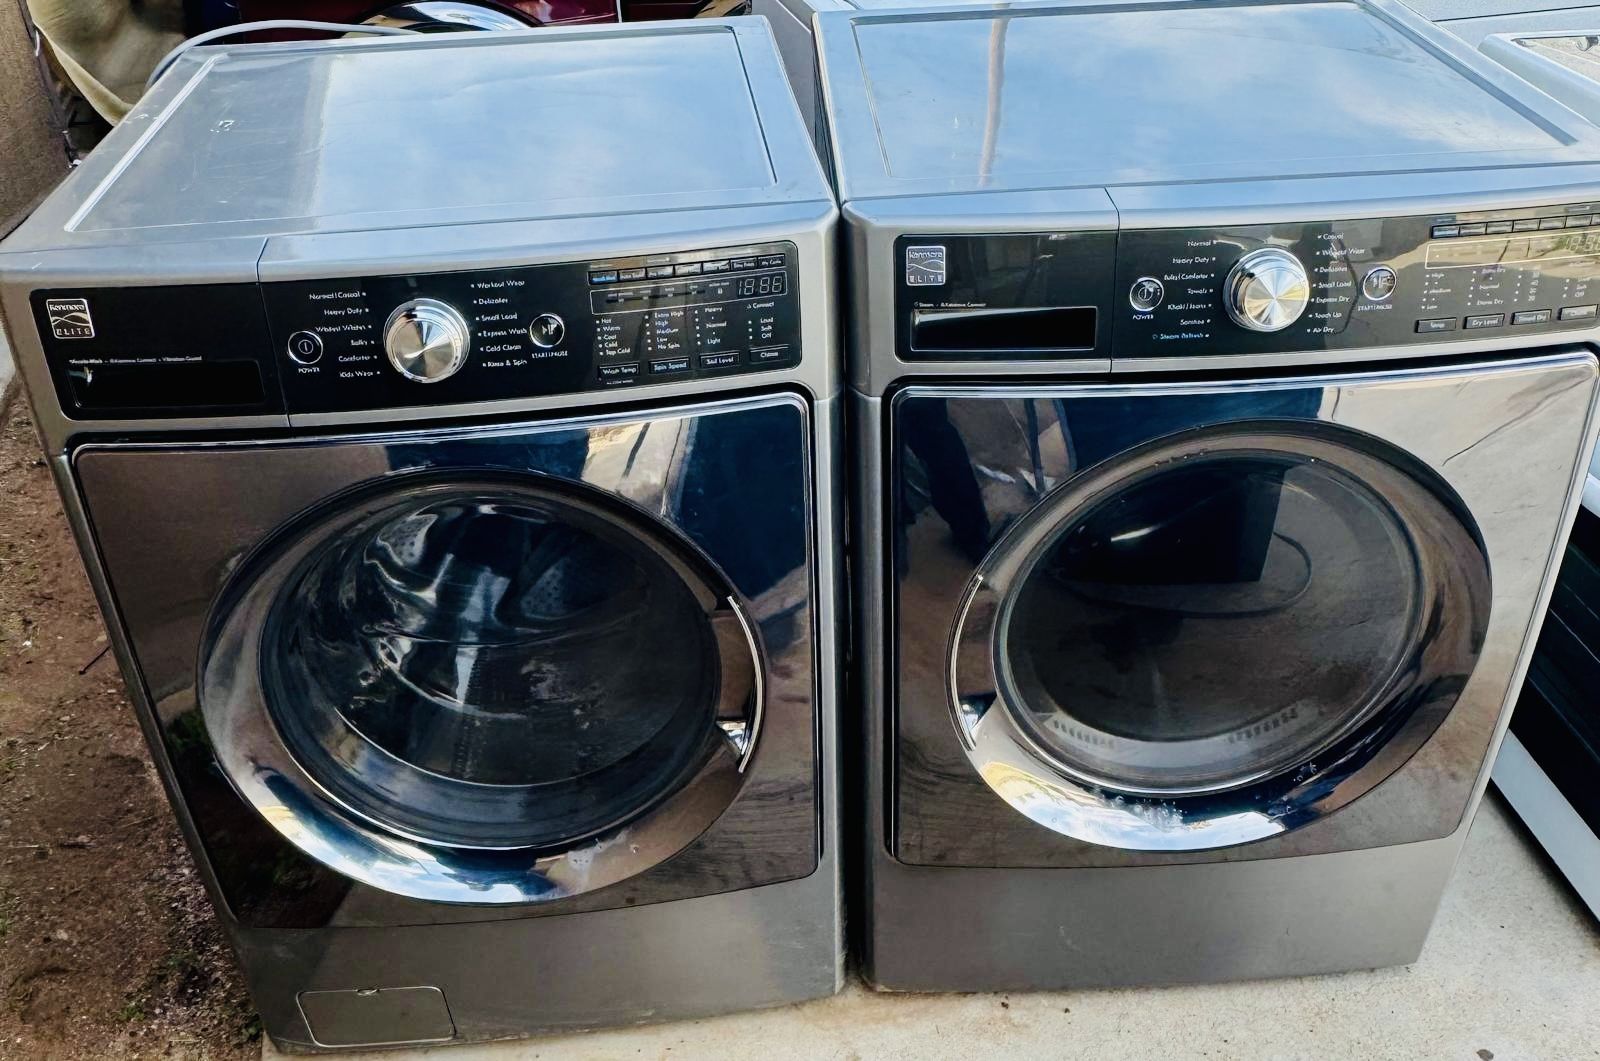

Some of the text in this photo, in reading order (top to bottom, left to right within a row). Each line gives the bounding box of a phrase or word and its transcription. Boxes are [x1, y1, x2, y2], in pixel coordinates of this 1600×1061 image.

[1322, 232, 1344, 241] Casual
[908, 250, 943, 259] Kenmore
[909, 275, 943, 283] ELITE
[1336, 281, 1352, 289] Load
[481, 312, 518, 322] Small Load
[55, 328, 91, 336] ELITE
[1322, 326, 1335, 334] Dry
[621, 366, 638, 374] Temp
